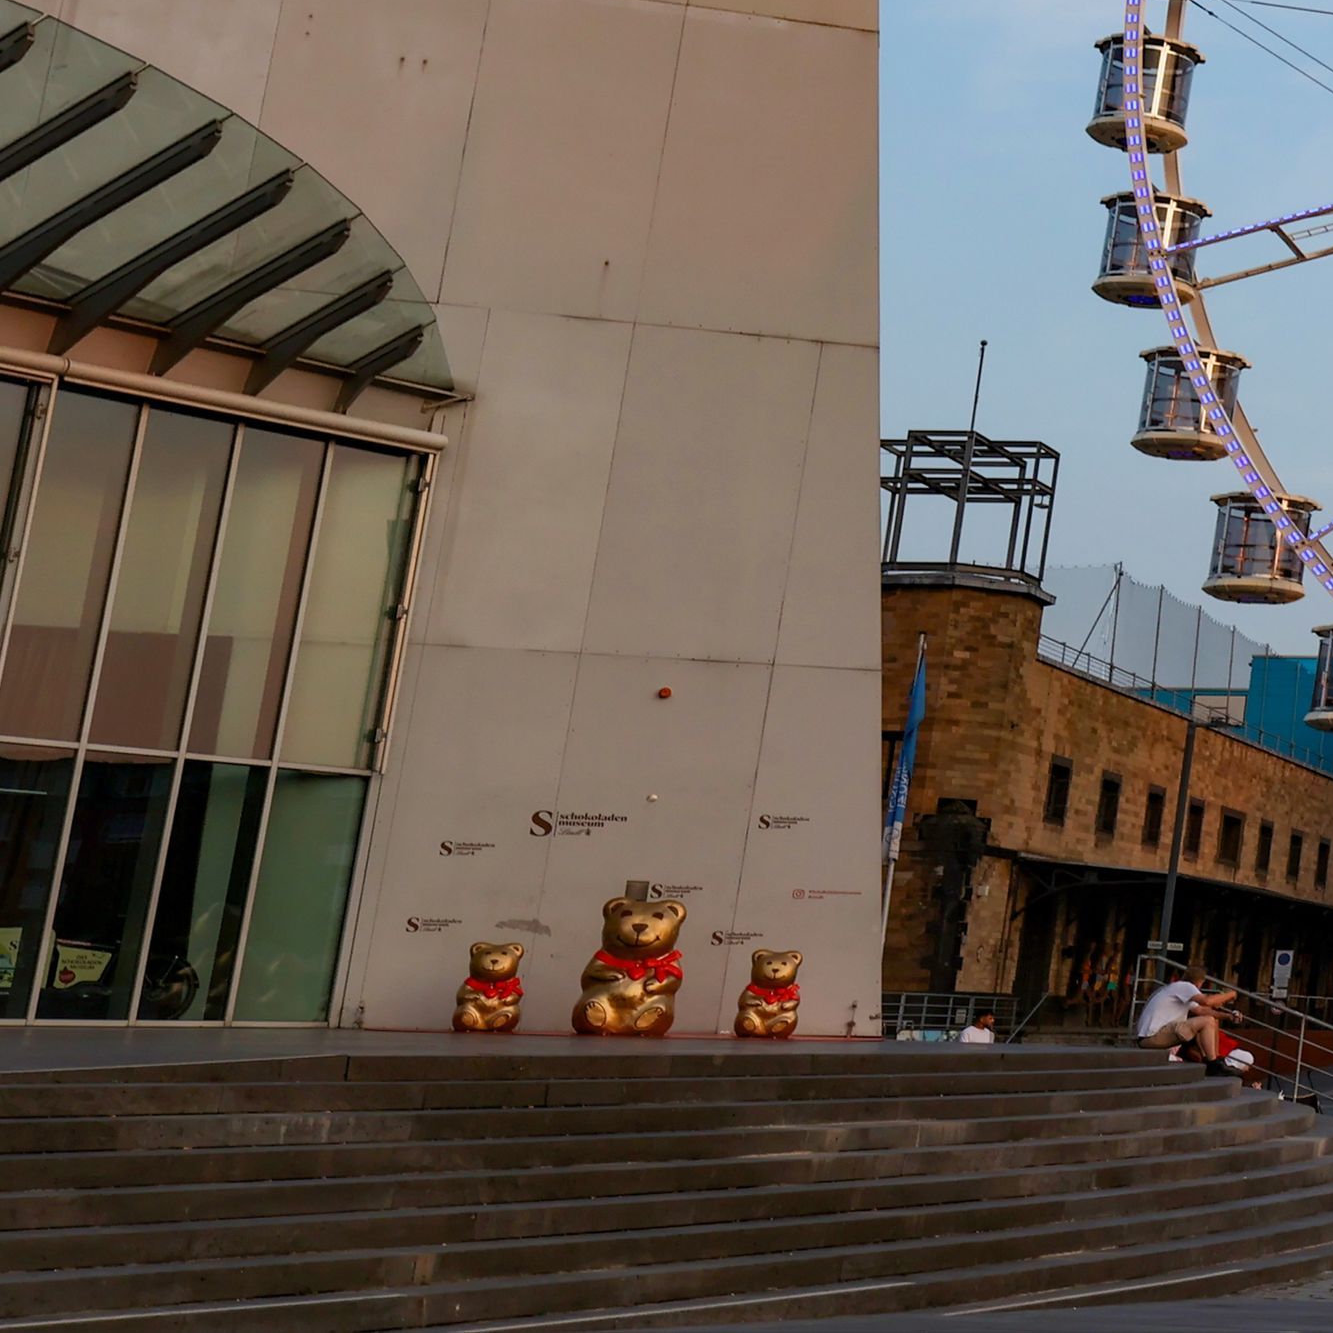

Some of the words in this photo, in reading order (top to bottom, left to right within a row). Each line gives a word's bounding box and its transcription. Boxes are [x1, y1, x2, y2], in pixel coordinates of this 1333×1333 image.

[530, 810, 553, 837] S
[558, 820, 605, 828] museum
[559, 812, 628, 822] schokoladen
[758, 814, 771, 829] S
[439, 840, 453, 856] S
[650, 883, 663, 898] S
[406, 916, 419, 932] S
[711, 930, 724, 946] S
